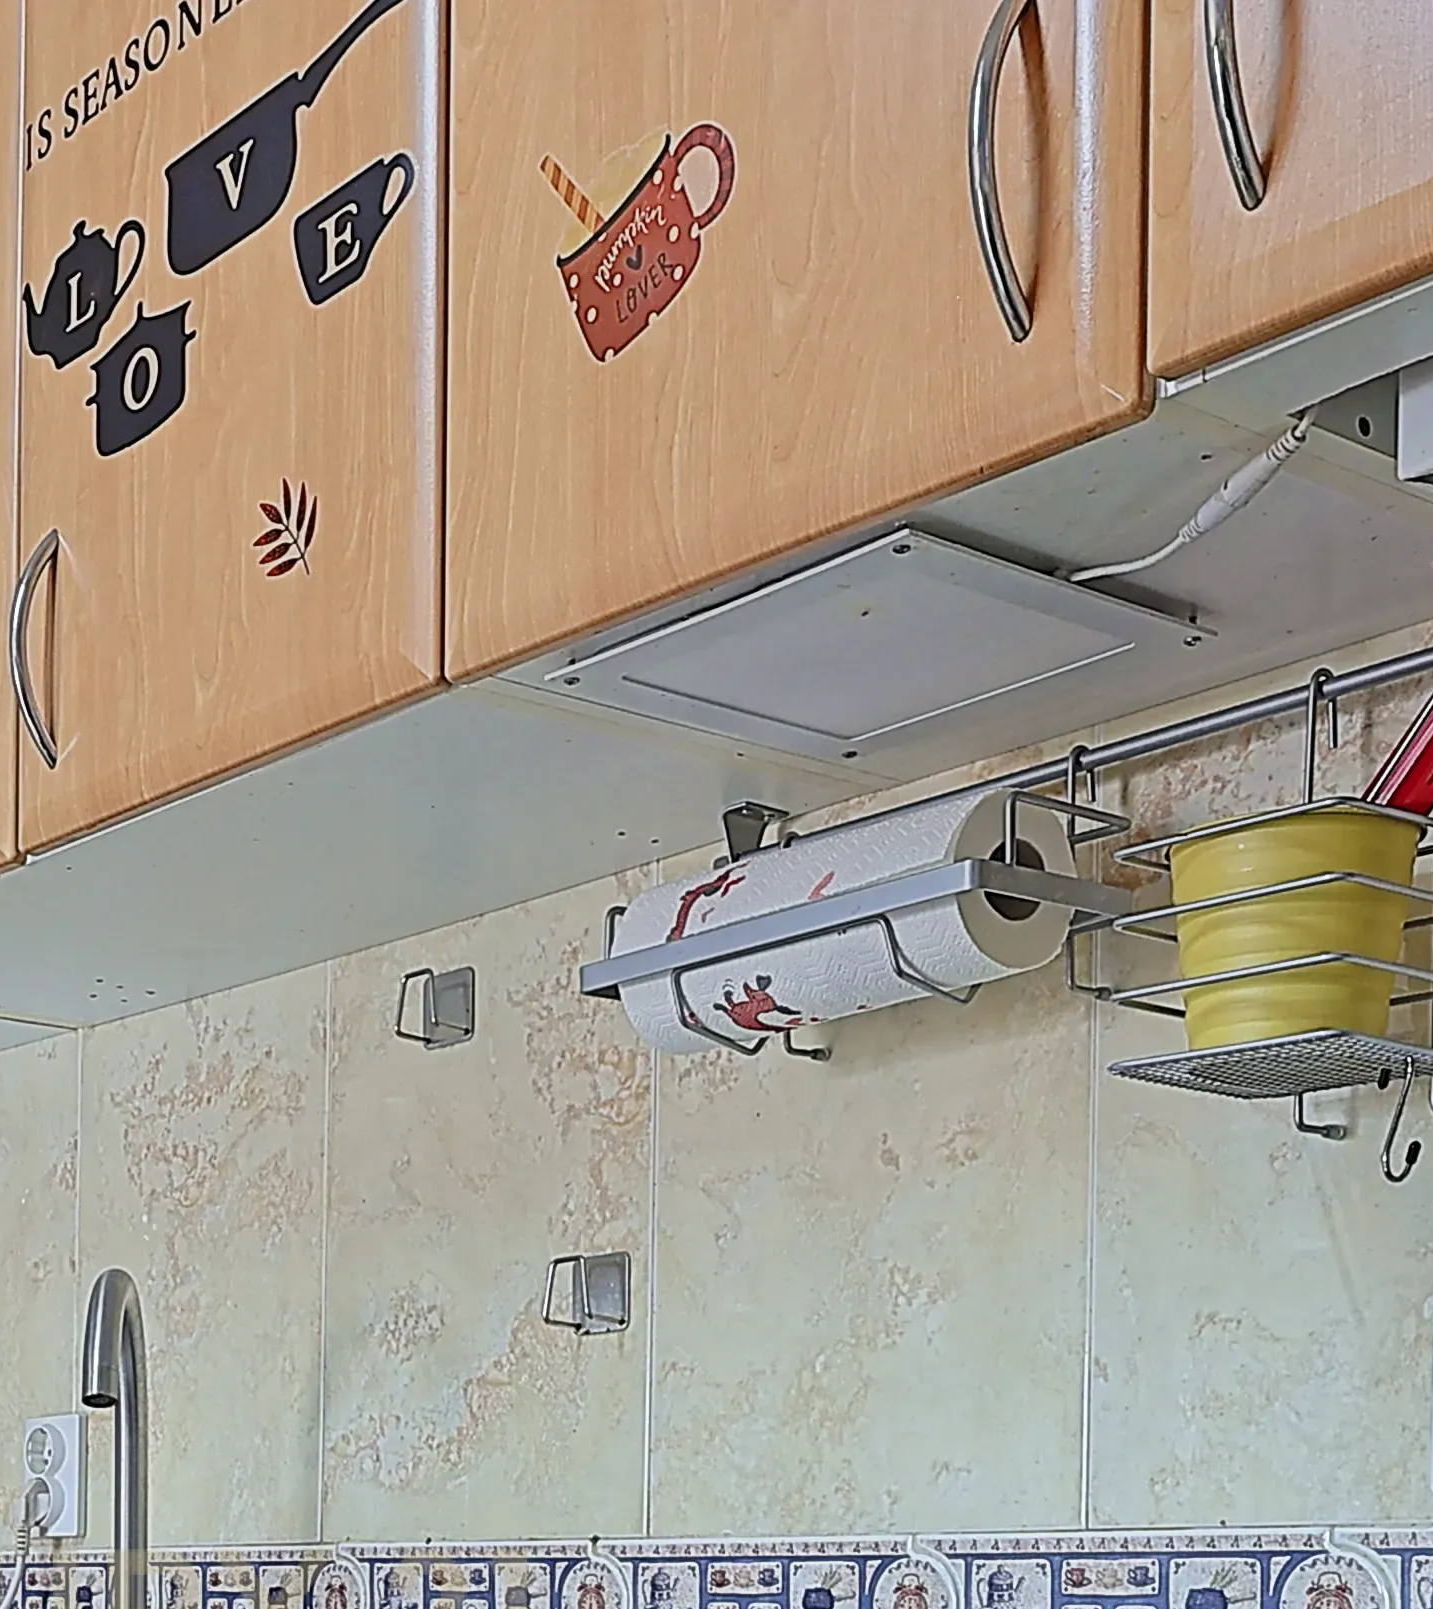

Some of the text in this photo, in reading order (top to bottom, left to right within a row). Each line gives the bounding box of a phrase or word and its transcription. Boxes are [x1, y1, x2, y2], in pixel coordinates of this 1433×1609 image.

[25, 0, 243, 171] IS SEASON
[594, 205, 667, 292] pumpkin
[615, 252, 675, 323] LOVER
